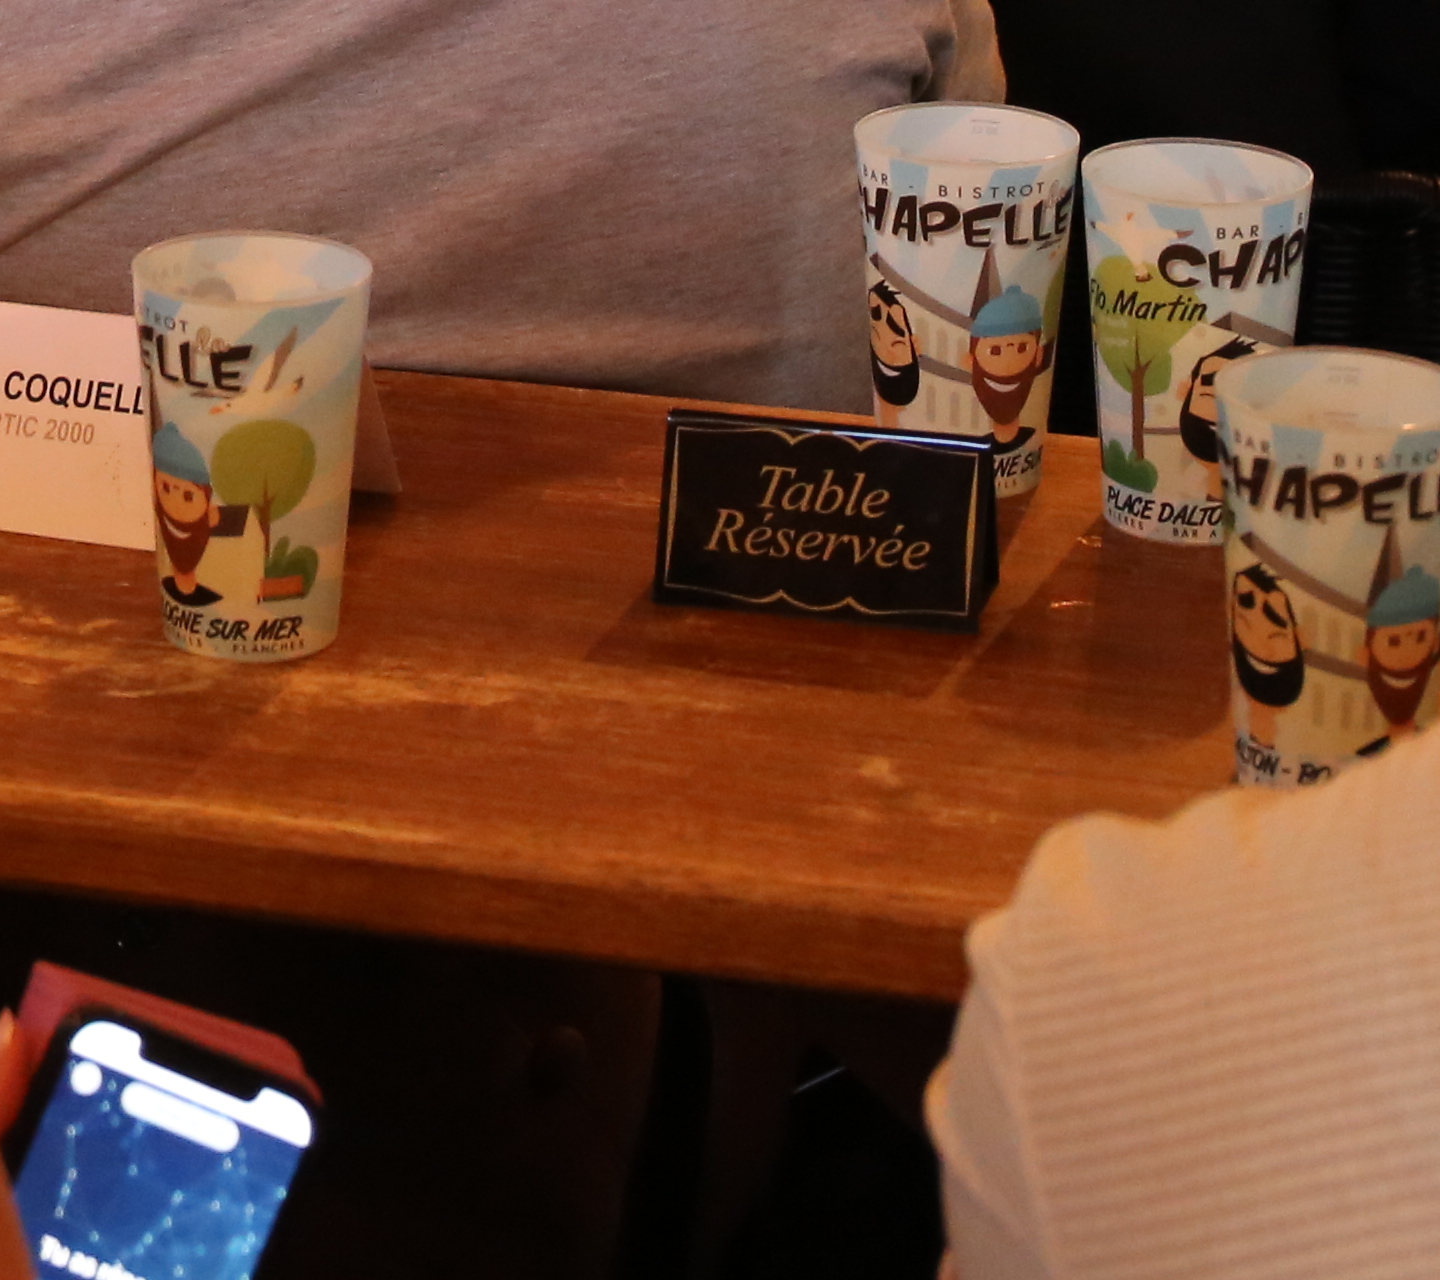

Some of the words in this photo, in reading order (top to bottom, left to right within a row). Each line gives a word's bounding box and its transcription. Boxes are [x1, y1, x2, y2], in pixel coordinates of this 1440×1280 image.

[862, 163, 889, 186] BAR
[938, 181, 1045, 199] BISTROT
[859, 184, 1075, 248] HAPELLE
[1216, 225, 1259, 240] BAR
[44, 418, 96, 445] 2000
[757, 465, 891, 519] Table
[1107, 486, 1156, 521] PLACE
[703, 508, 932, 571] Réservée
[206, 618, 250, 641] SUR
[254, 616, 303, 641] MER
